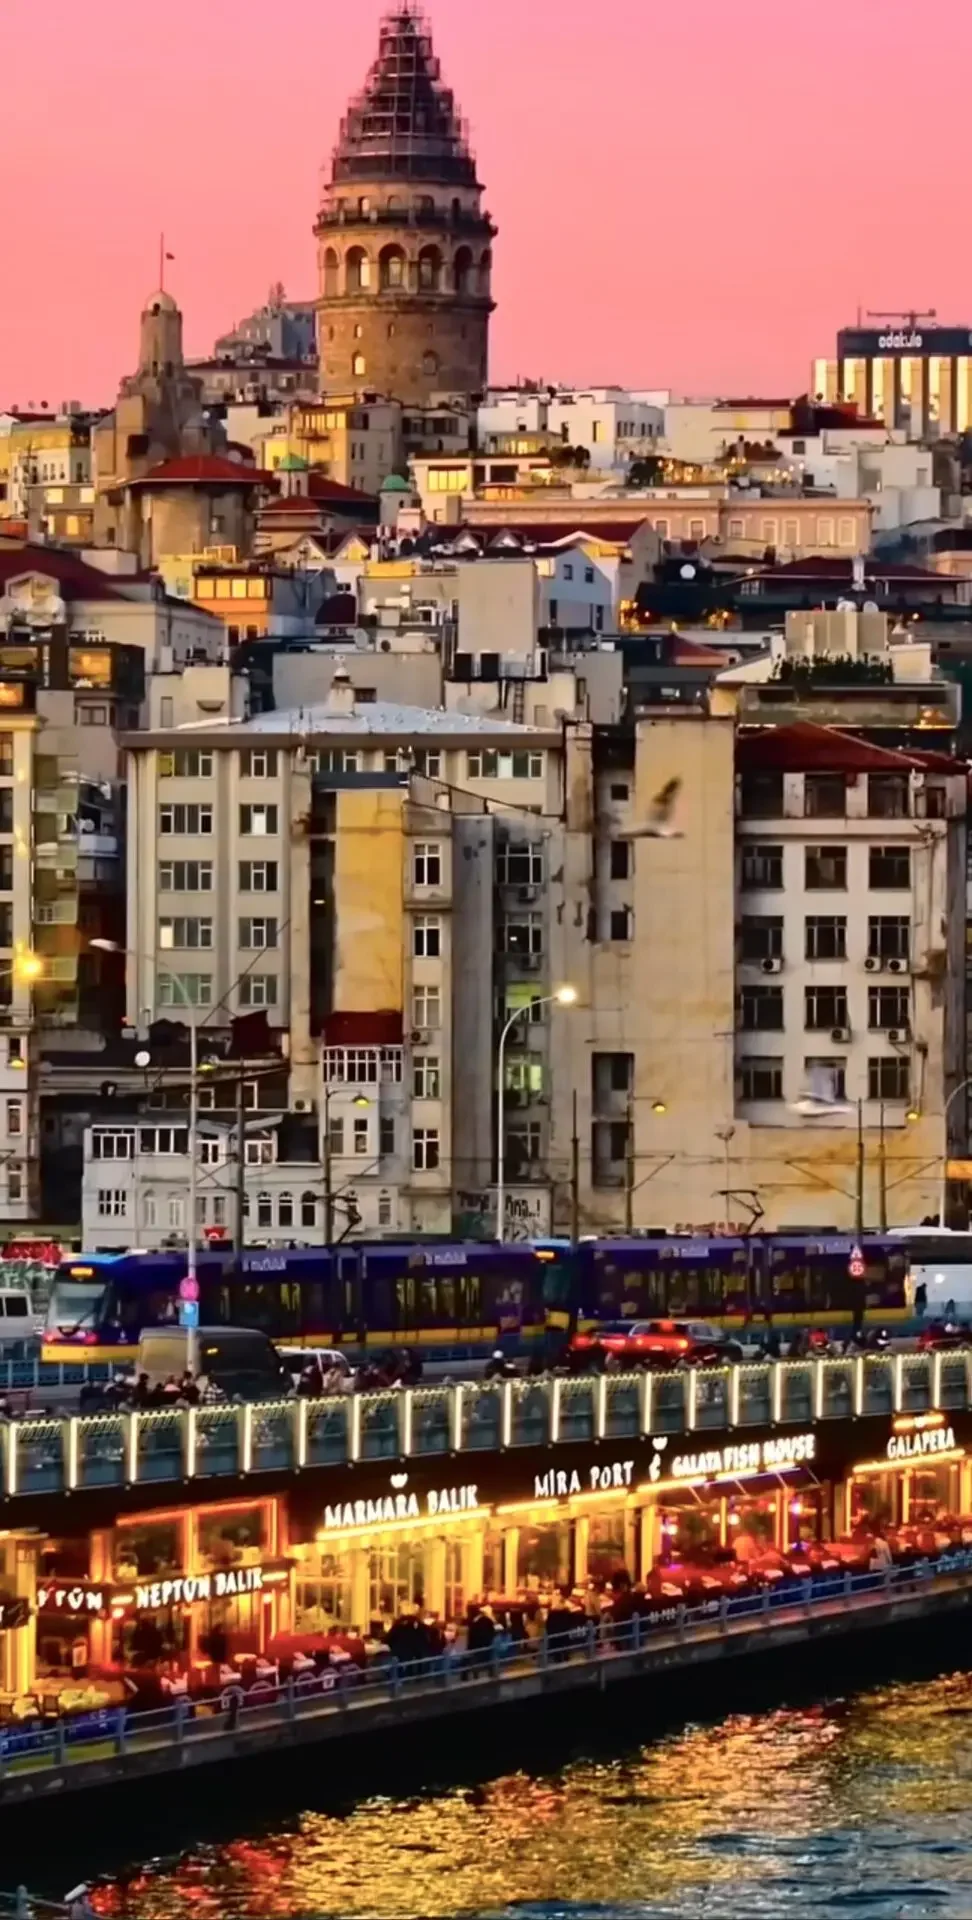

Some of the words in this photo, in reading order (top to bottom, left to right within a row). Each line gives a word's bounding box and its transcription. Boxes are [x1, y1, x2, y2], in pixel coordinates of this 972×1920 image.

[590, 1461, 634, 1490] PORT
[672, 1450, 722, 1477] GALATA
[723, 1442, 760, 1471] FISH
[763, 1433, 816, 1463] HOUSE
[887, 1427, 955, 1459] GALAPERA
[324, 1492, 420, 1528] MARMARA
[427, 1484, 478, 1516] BALIK
[215, 1566, 263, 1596] BALIK
